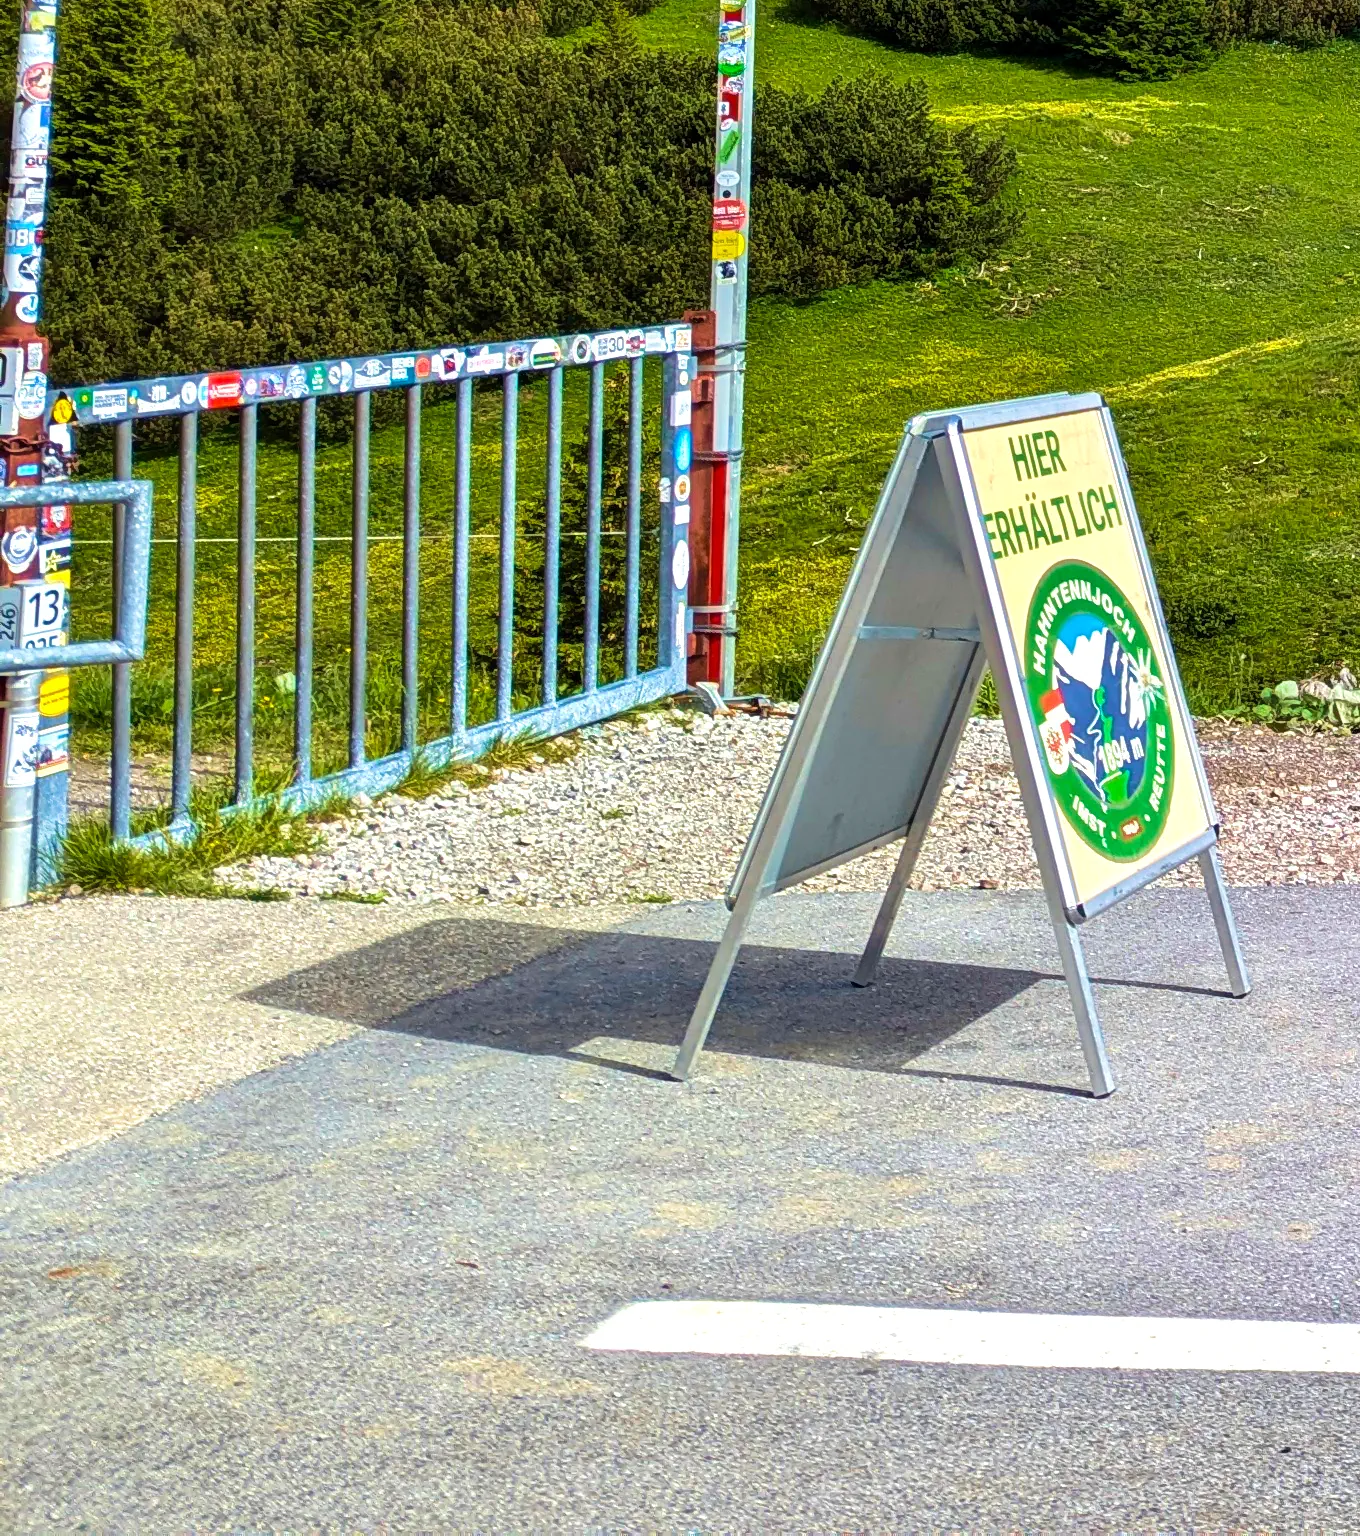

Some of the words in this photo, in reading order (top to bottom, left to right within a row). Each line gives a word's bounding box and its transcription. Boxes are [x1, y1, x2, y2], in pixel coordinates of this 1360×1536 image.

[1008, 430, 1067, 481] HIER
[983, 484, 1123, 560] ERHÄLTLICH
[29, 589, 60, 628] 13
[1032, 578, 1136, 675] HAHNTENNJOCH
[1098, 735, 1132, 774] 1894
[1149, 723, 1167, 810] REUTTE
[1072, 794, 1106, 837] IMST
